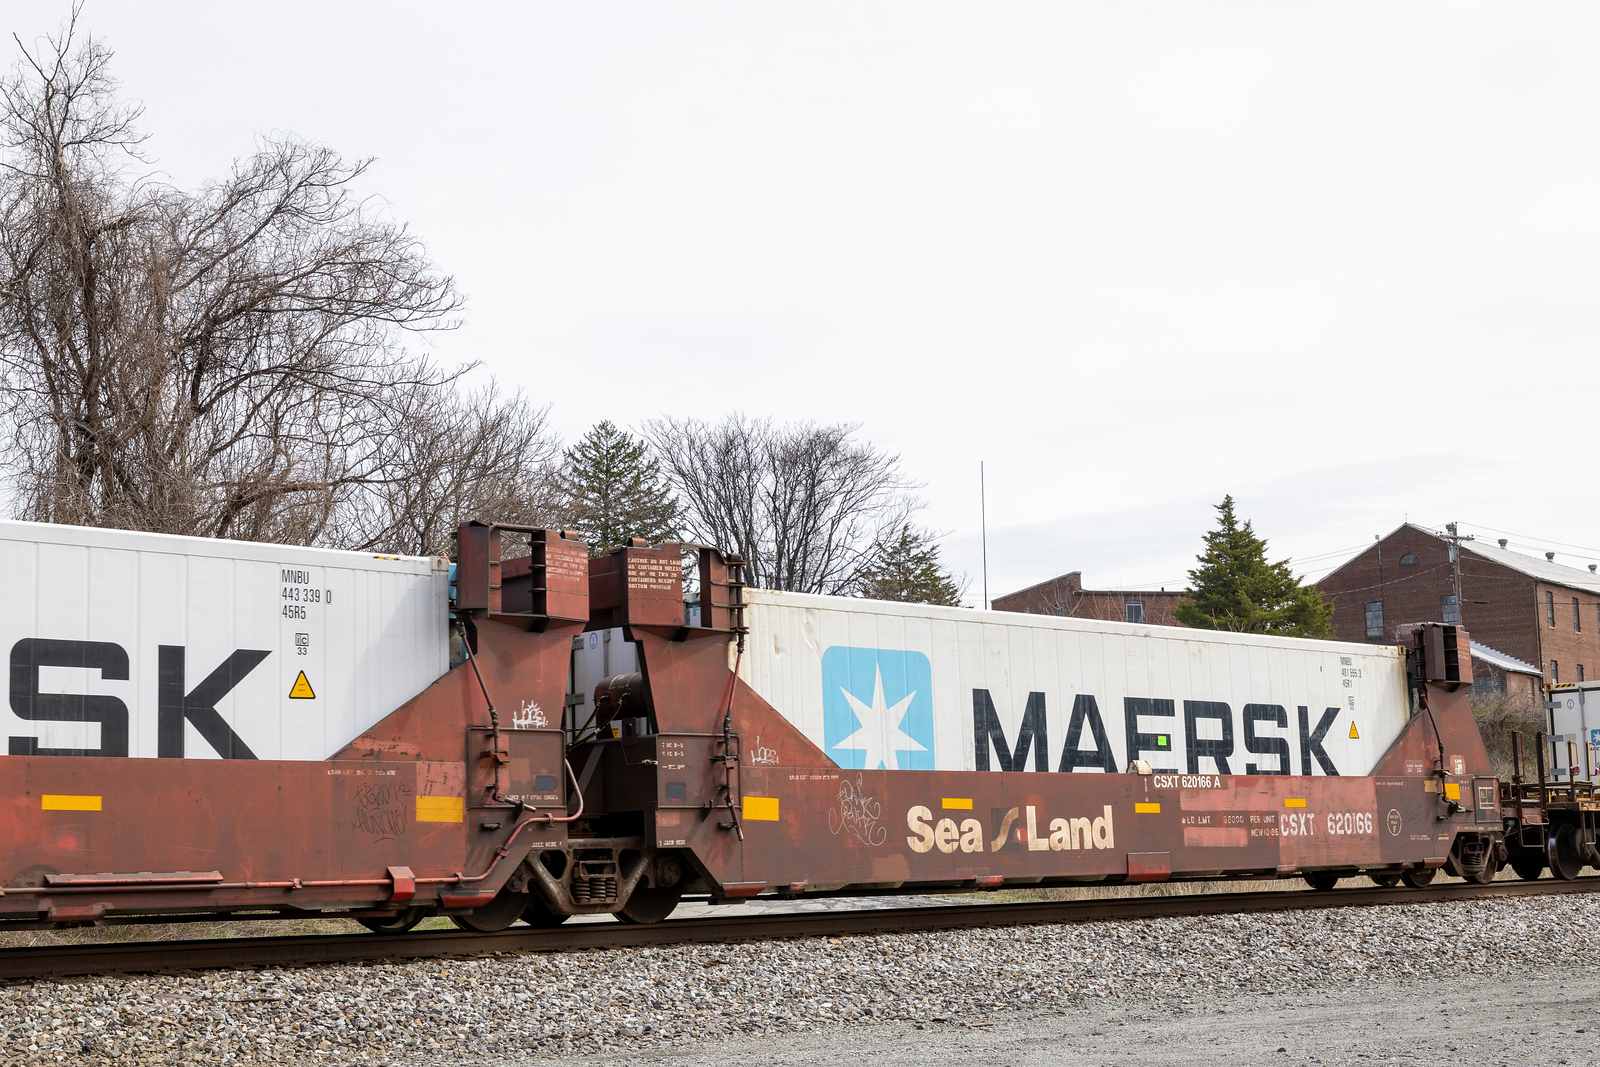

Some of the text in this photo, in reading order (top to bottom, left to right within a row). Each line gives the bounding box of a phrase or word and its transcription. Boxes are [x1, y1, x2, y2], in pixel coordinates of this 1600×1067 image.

[282, 569, 309, 584] MNBU
[282, 587, 300, 601] 443
[303, 588, 320, 602] 339
[282, 605, 306, 619] 45R5
[297, 647, 307, 655] 33
[972, 688, 1341, 776] MAERSK
[1154, 775, 1221, 788] CSXT 620166 A
[1198, 816, 1211, 824] LMT
[1280, 814, 1314, 836] CSXT
[1327, 812, 1372, 835] 620166
[907, 806, 983, 853] Sea
[1026, 805, 1114, 851] Land
